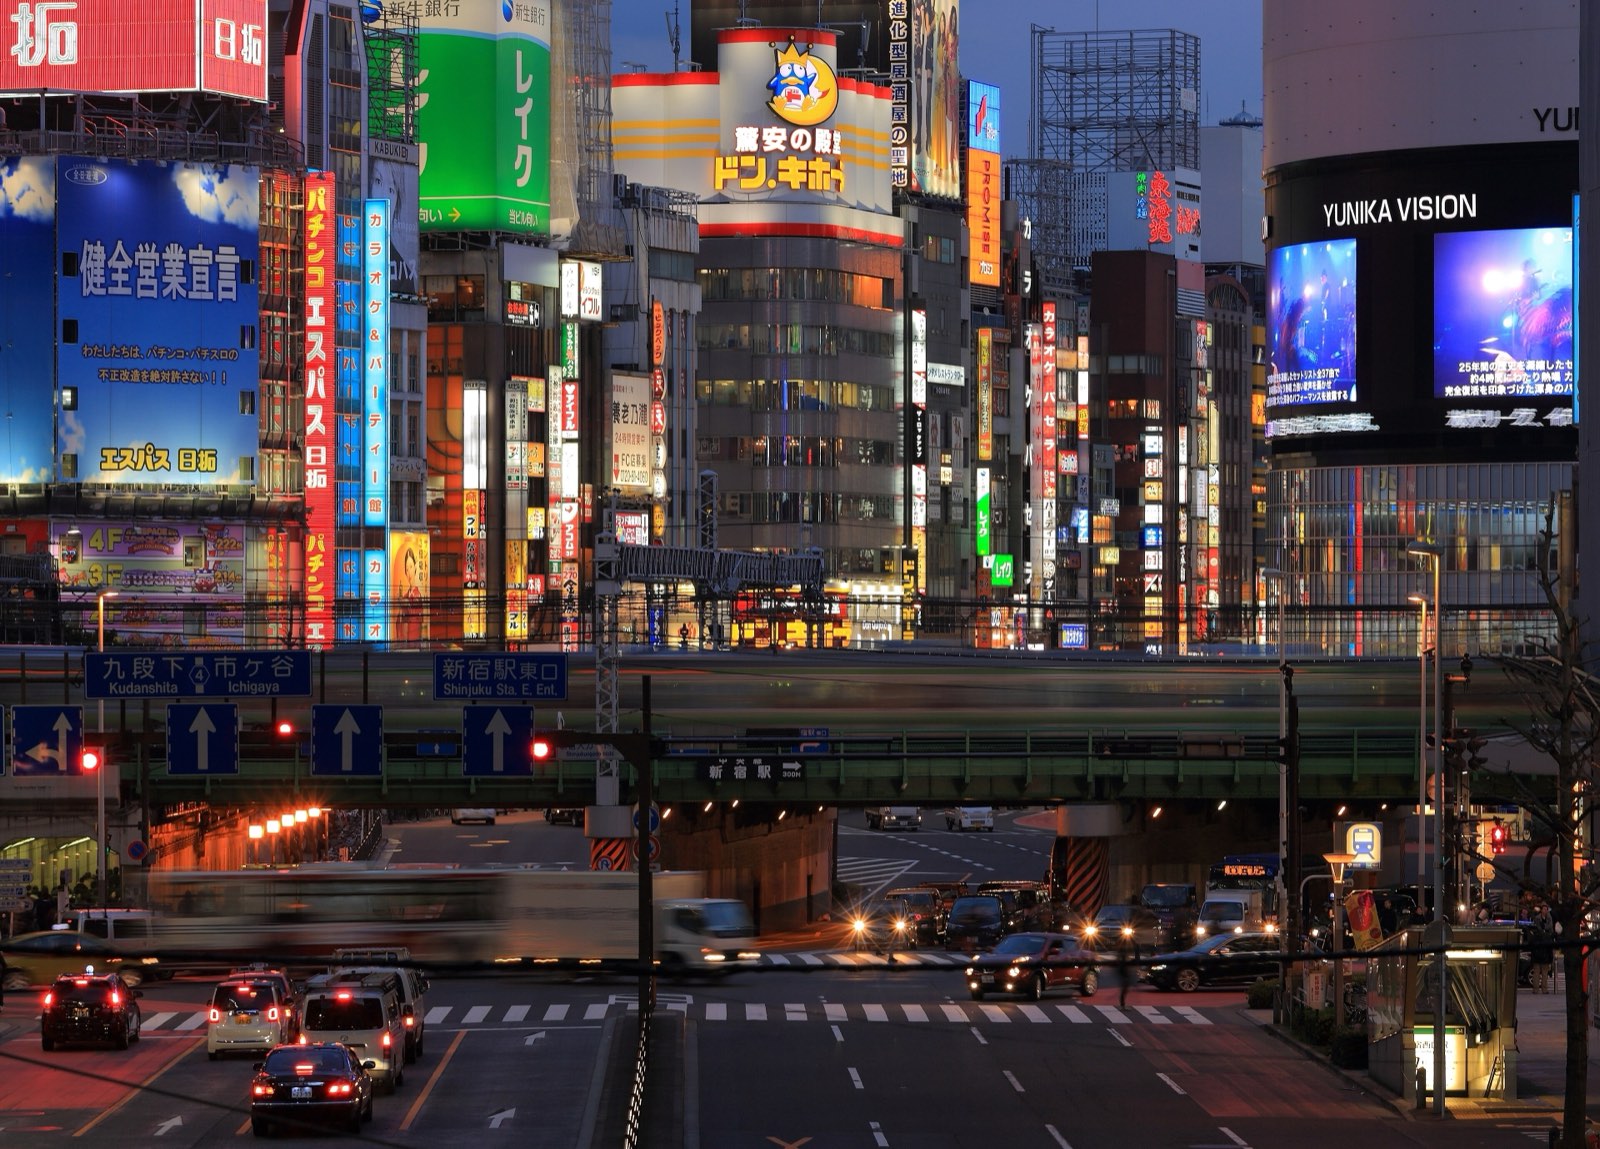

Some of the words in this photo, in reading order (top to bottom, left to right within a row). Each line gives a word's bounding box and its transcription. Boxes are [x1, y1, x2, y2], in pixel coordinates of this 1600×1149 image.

[515, 4, 545, 26] 新生銀行
[11, 2, 78, 66] 拓
[215, 17, 262, 65] 日拓
[514, 49, 533, 188] レイク
[1533, 107, 1579, 132] YU
[981, 159, 991, 255] PROMISE
[1323, 198, 1392, 228] YUNIKA
[1396, 193, 1477, 222] VISION
[306, 187, 328, 288] パチンコ
[79, 239, 240, 302] 健全営業宣言
[82, 343, 239, 361] わたしたちは、パチンコ・パチスロの
[1043, 310, 1055, 373] カラオケ
[306, 296, 328, 436] エスパス
[565, 394, 575, 431] アイフル
[100, 442, 170, 471] エスパス
[178, 448, 218, 472] 日拓
[306, 445, 328, 489] 日拓
[565, 524, 574, 550] アコム
[979, 510, 987, 537] レイク
[89, 527, 122, 552] 4F
[89, 563, 123, 587] 3F
[995, 561, 1012, 578] レイク
[103, 656, 185, 680] 九段下
[194, 668, 204, 681] 4
[442, 658, 558, 681] 新宿駅東口
[109, 681, 179, 695] Kudanshita
[228, 681, 280, 695] Ichigaya
[443, 683, 492, 697] Shinjuku
[496, 683, 517, 695] Sta.
[522, 683, 532, 696] E.
[536, 683, 558, 696] Ent.
[709, 765, 771, 779] 新宿駅
